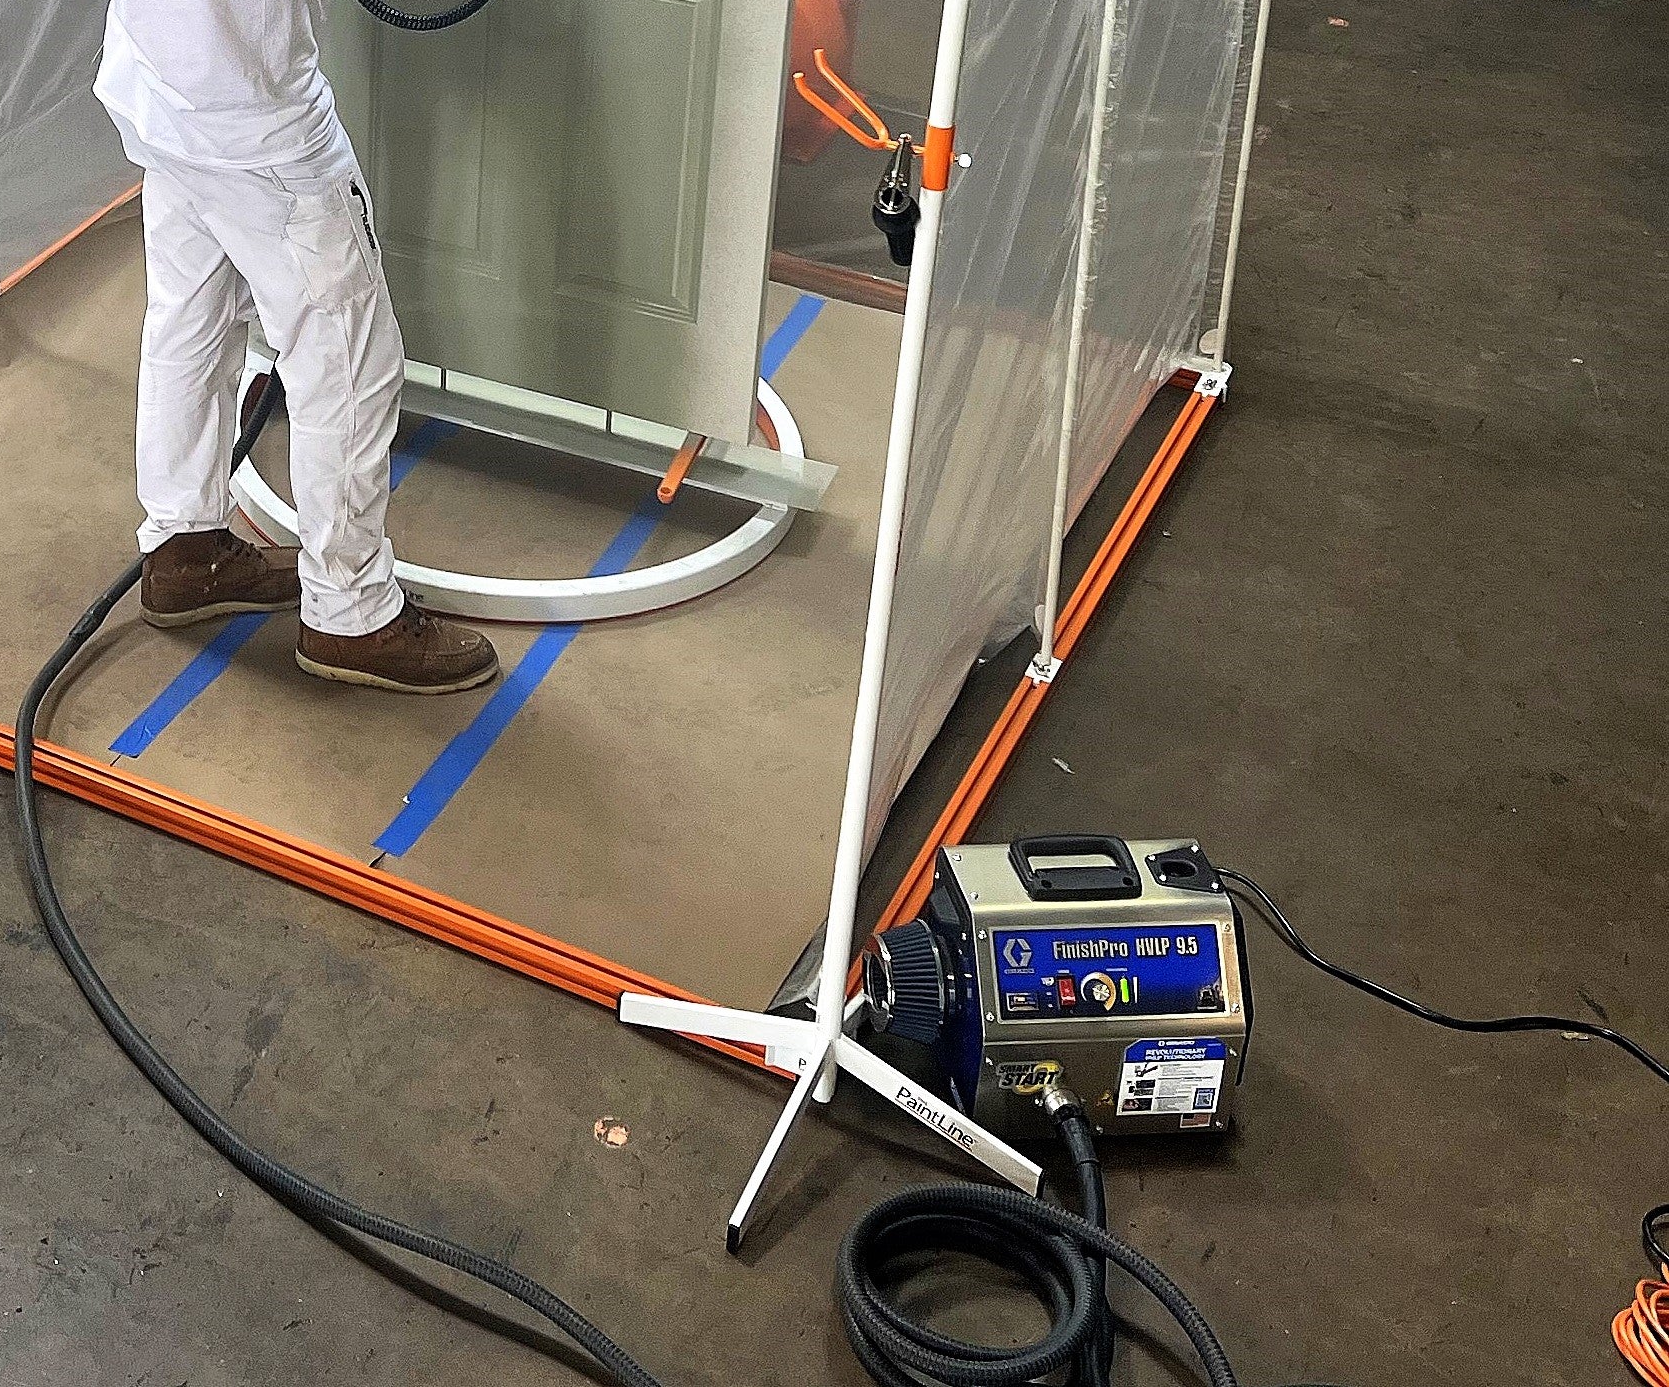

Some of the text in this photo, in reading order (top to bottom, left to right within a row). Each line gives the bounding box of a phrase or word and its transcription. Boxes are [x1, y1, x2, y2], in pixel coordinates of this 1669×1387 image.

[1052, 935, 1198, 960] FinishPro HVLP 9.5
[1001, 1072, 1060, 1086] START
[895, 1085, 975, 1148] PaintLine
